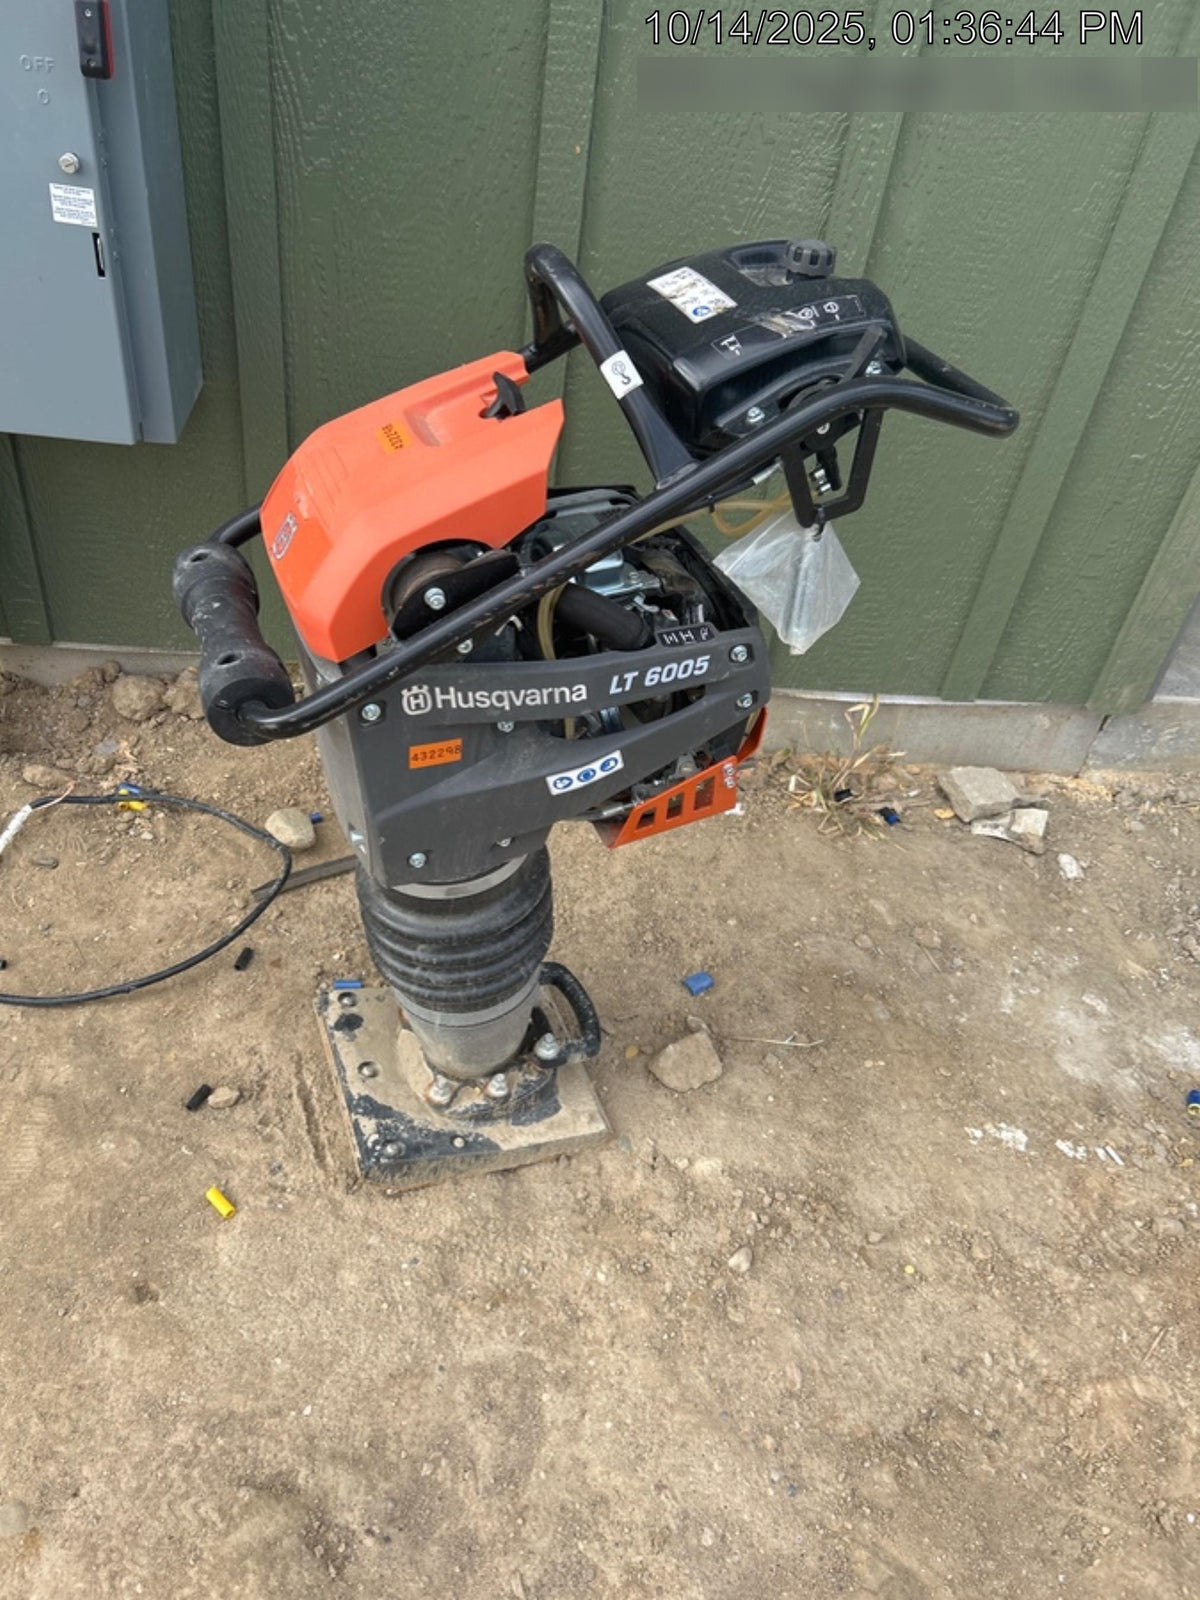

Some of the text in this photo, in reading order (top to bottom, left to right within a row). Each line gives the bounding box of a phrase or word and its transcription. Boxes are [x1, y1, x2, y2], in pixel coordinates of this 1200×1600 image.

[19, 54, 55, 73] OFF
[609, 654, 711, 695] LT 6005
[434, 683, 588, 711] Husqvarna
[411, 744, 462, 762] 432298
